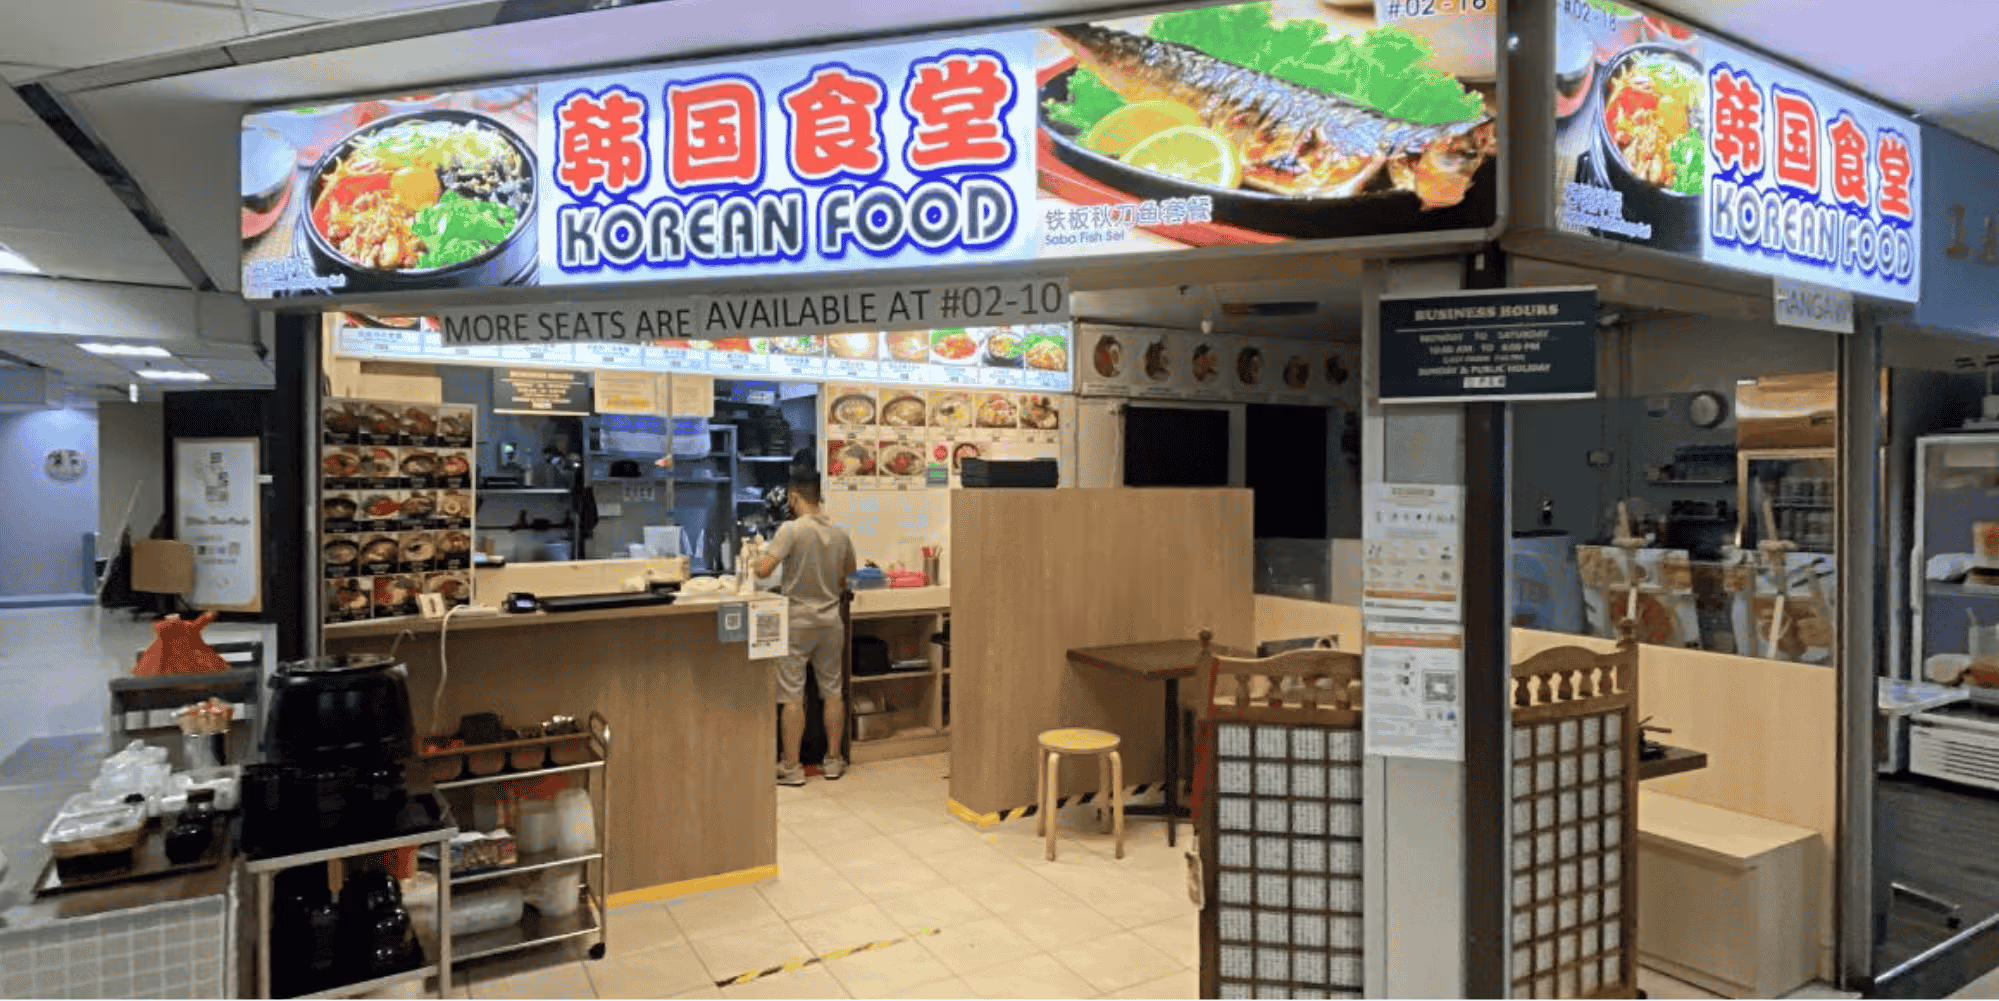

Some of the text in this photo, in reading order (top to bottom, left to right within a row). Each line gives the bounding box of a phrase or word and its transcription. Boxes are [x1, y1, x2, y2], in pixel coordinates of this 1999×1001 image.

[557, 54, 1012, 196] 韩国食堂
[1712, 68, 1913, 220] 韩国食堂
[559, 176, 1014, 268] KOREAN FOOD
[1711, 177, 1838, 263] KOREAN
[1840, 213, 1912, 280] FOOD
[444, 281, 1063, 343] MORE SEATS ARE AVAILABLE AT #02-10
[1414, 303, 1559, 321] BUSINESS HOURS
[1471, 364, 1505, 374] PUBLIC
[1507, 362, 1551, 373] HOLIDAY
